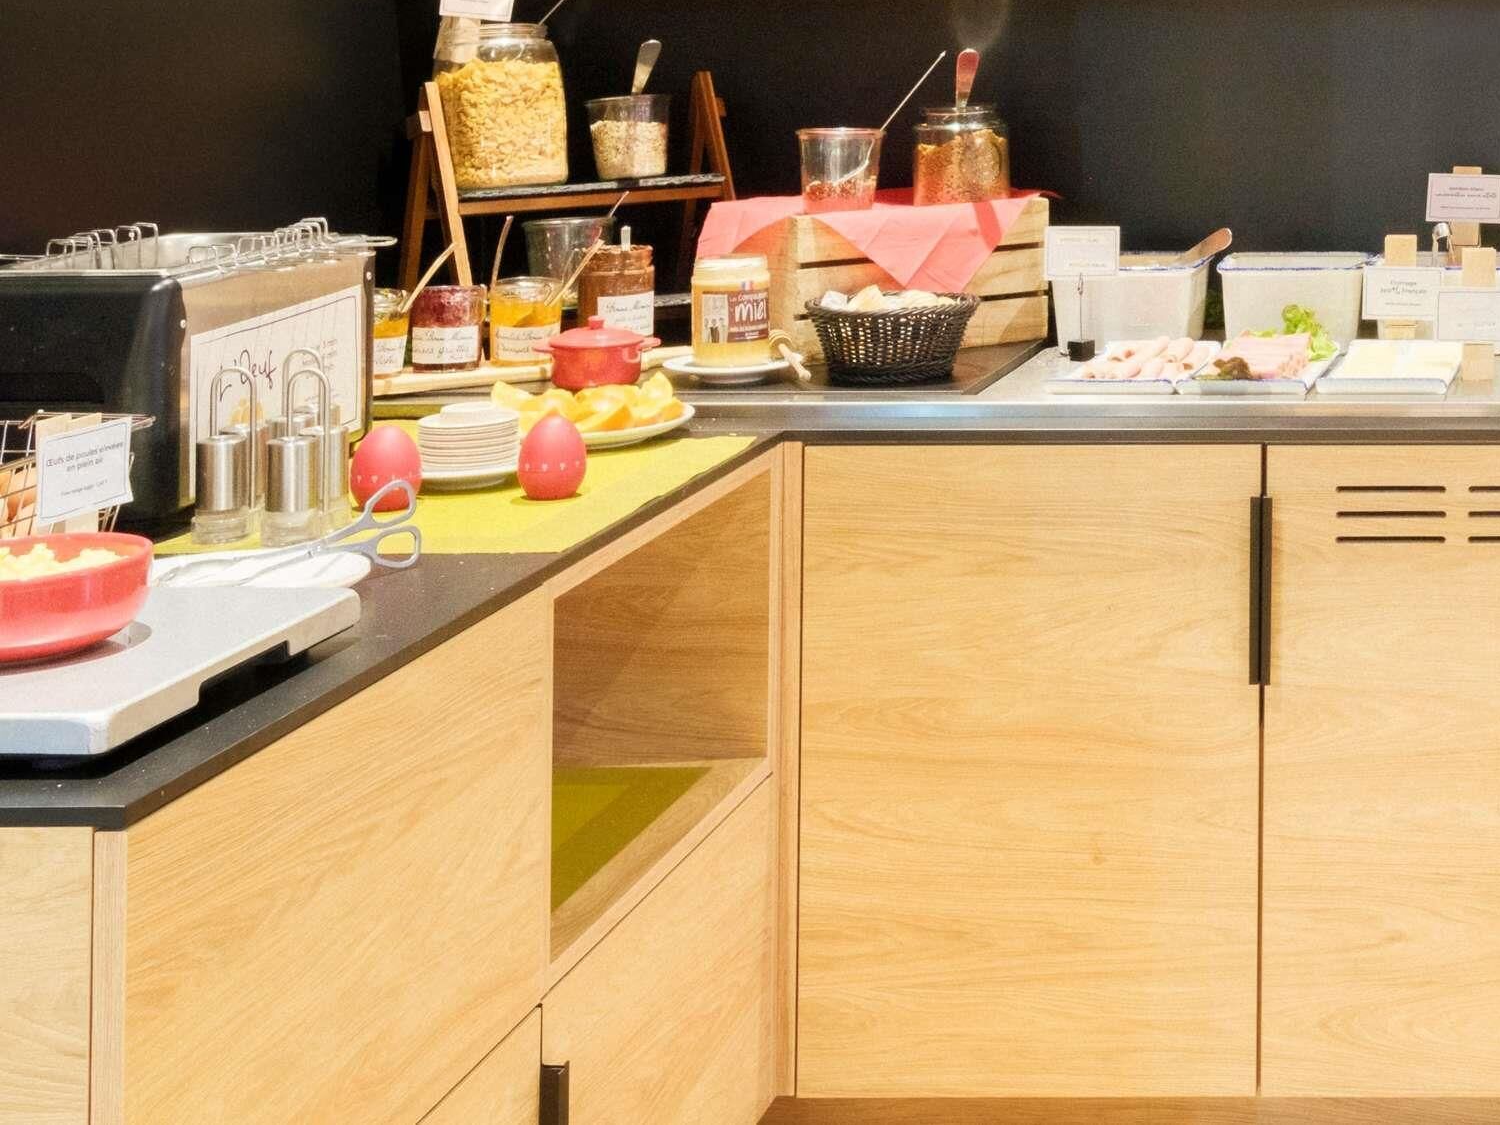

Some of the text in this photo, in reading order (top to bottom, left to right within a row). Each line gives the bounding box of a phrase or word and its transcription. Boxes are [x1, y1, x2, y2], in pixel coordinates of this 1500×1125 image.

[735, 298, 768, 323] miel
[66, 452, 76, 463] de
[76, 447, 99, 461] poules
[67, 463, 76, 473] en
[77, 457, 95, 471] plein
